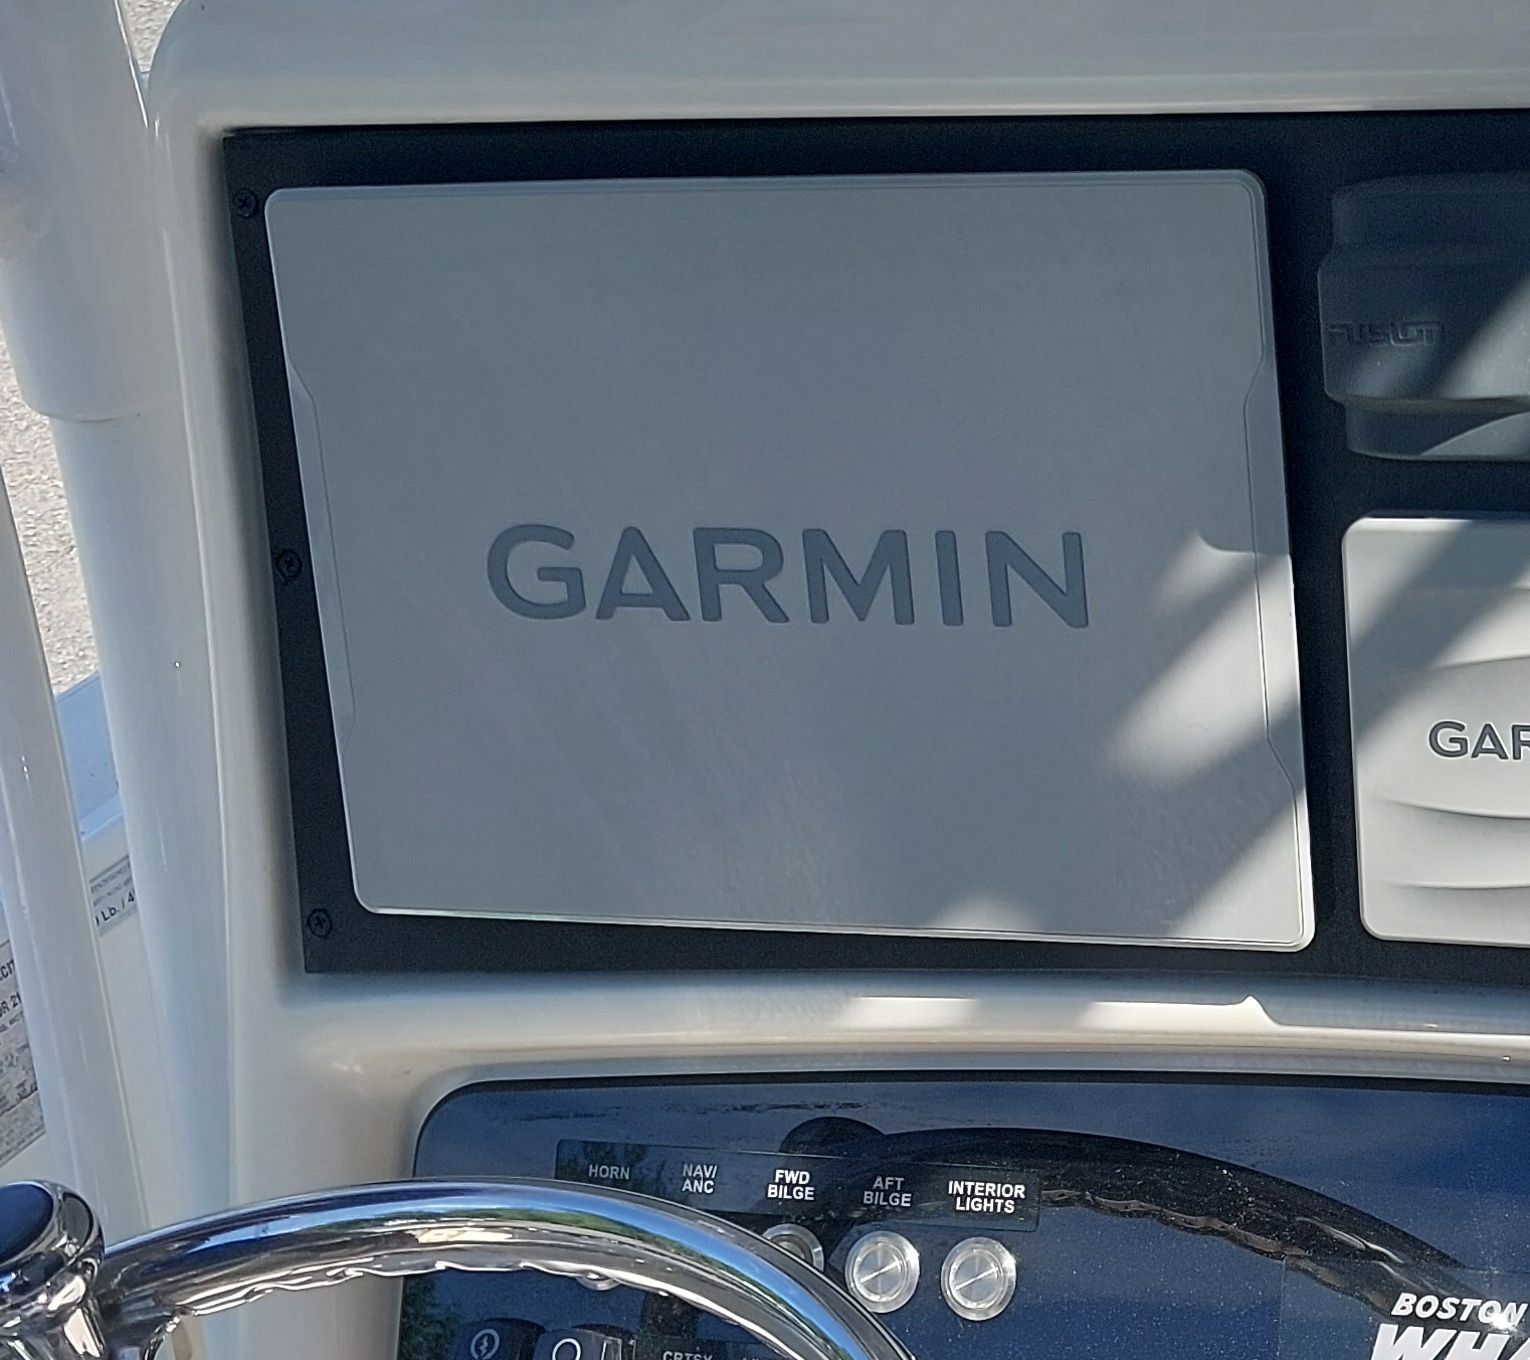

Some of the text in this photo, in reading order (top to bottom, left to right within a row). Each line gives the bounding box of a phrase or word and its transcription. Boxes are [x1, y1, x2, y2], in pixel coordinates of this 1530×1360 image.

[486, 523, 1090, 629] GARMIN
[588, 1164, 630, 1180] HORN
[774, 1169, 811, 1185] FWD
[682, 1178, 715, 1194] ANC
[872, 1176, 905, 1191] AFT
[948, 1180, 1026, 1199] INTERIOR
[767, 1184, 815, 1201] BILGE
[863, 1190, 912, 1207] BILGE
[955, 1196, 1015, 1214] LIGHTS
[1390, 1292, 1529, 1325] BOSTON
